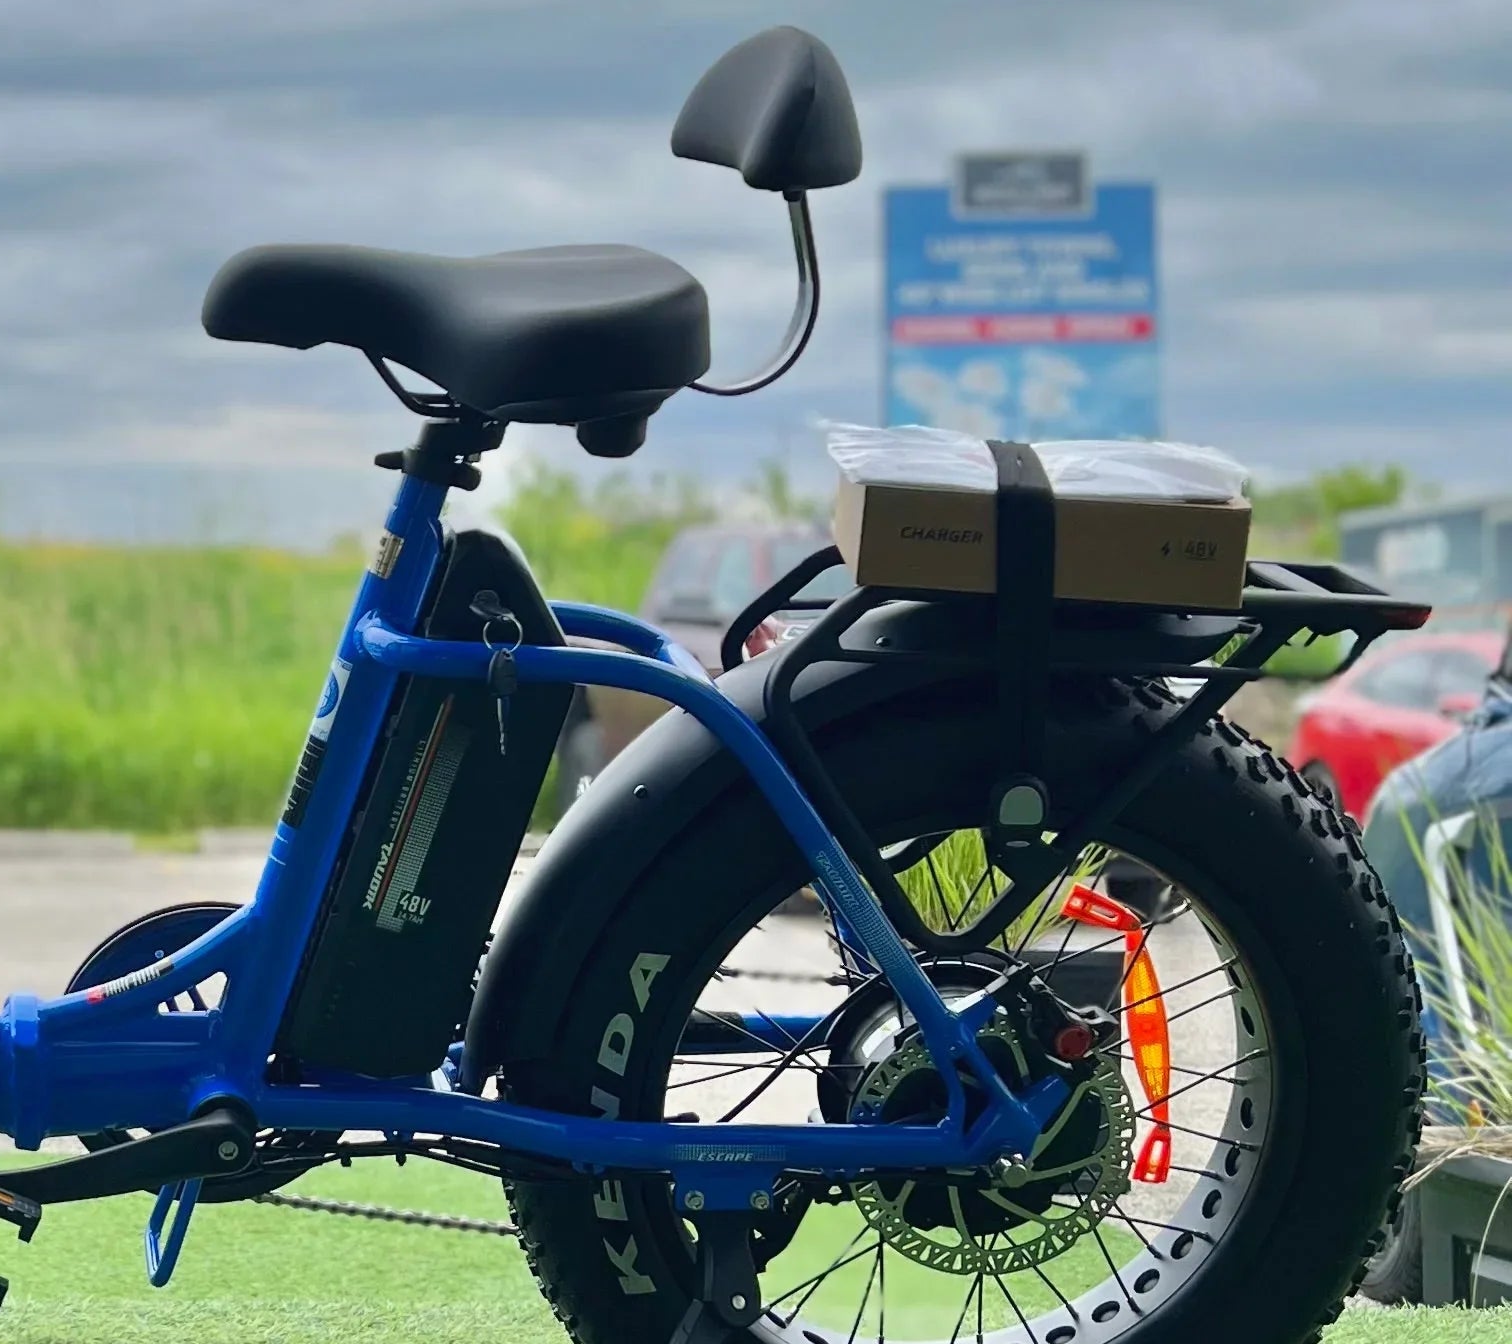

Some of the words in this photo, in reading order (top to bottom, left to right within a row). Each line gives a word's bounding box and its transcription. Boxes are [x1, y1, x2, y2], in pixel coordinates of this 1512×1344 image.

[899, 525, 984, 545] CHARGER
[399, 892, 432, 916] 48V
[696, 1152, 753, 1162] ESCAPE
